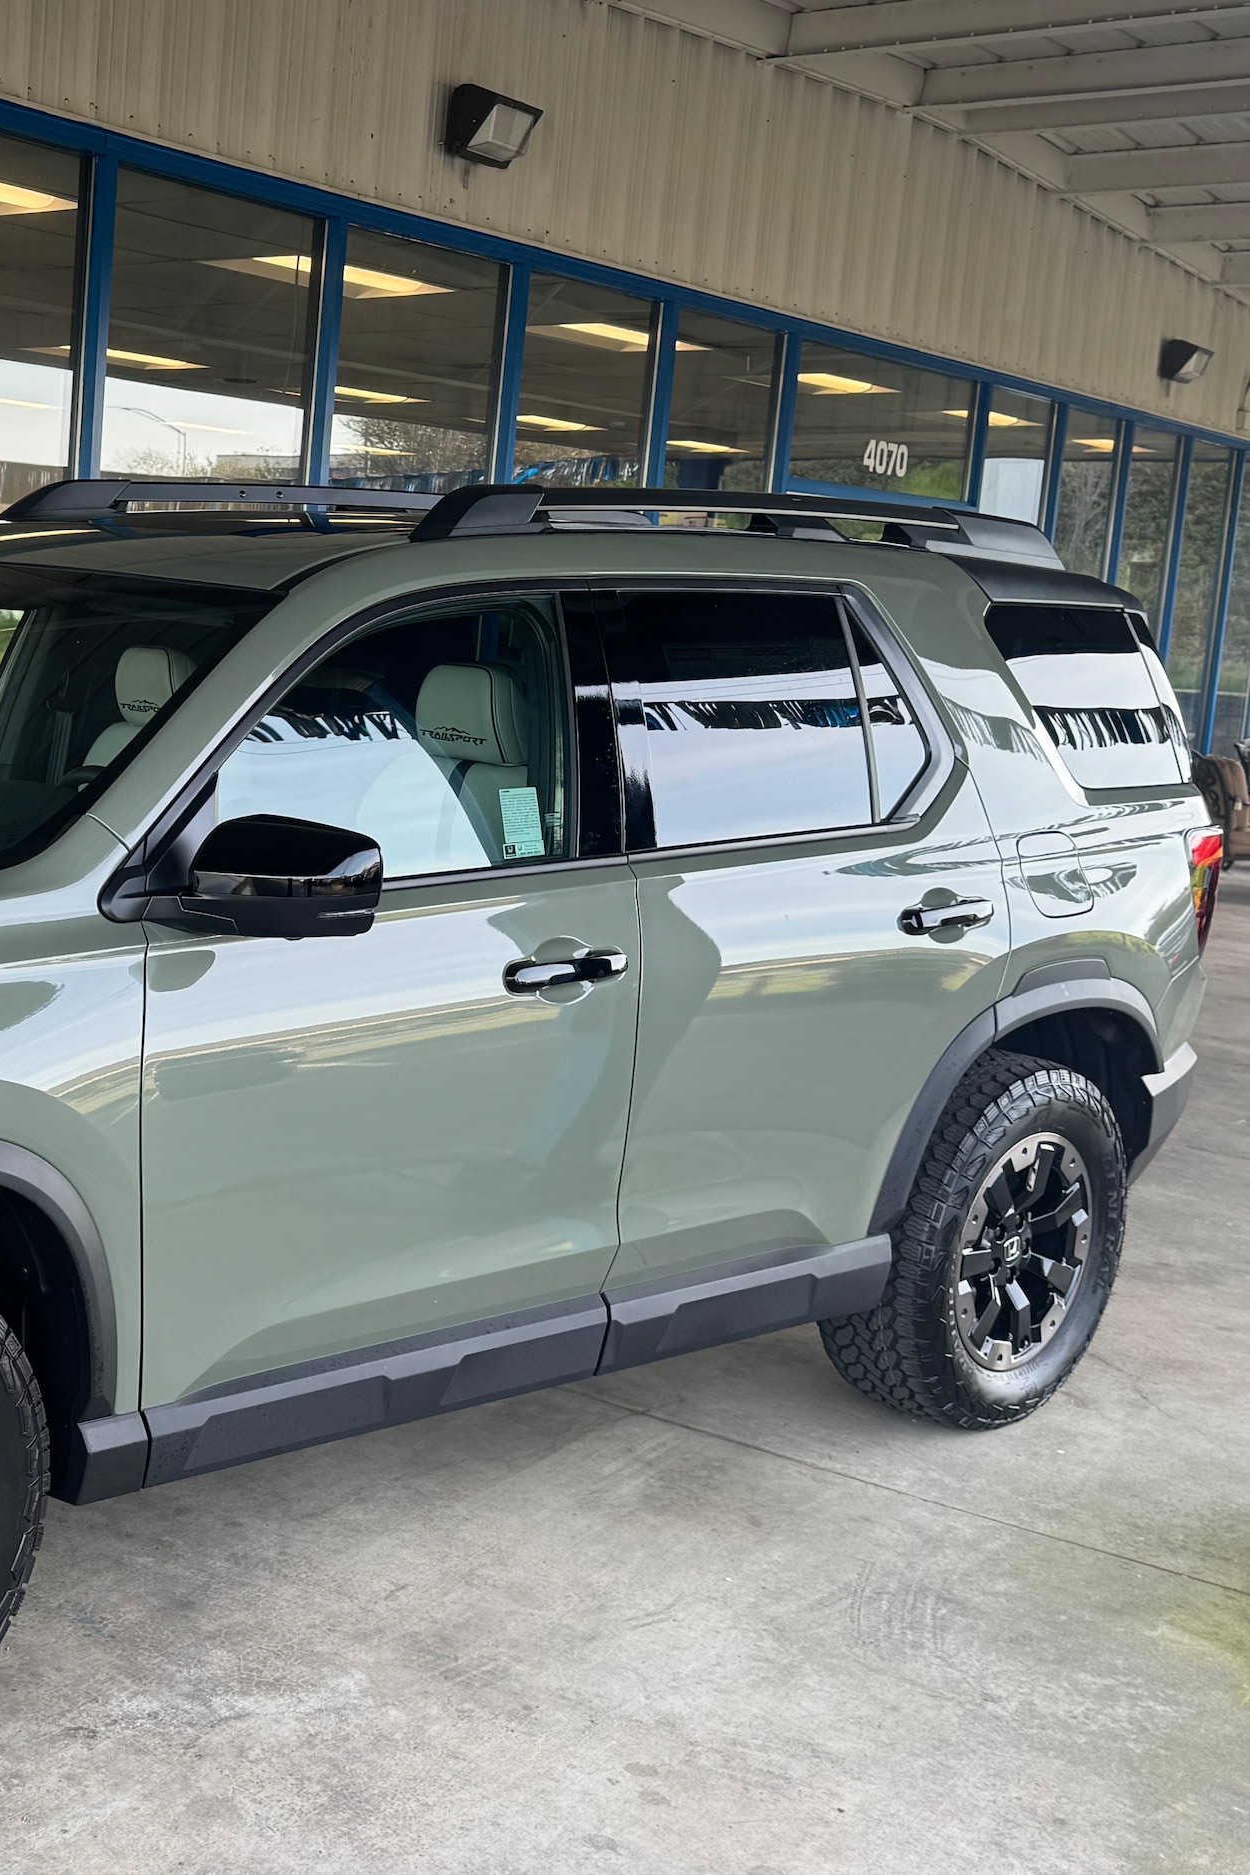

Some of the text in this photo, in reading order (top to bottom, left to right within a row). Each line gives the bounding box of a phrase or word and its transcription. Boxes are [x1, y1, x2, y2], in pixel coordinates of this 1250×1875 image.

[862, 438, 909, 478] 4070
[119, 702, 162, 713] TRAILSPO
[419, 728, 488, 747] TRAILSPORT
